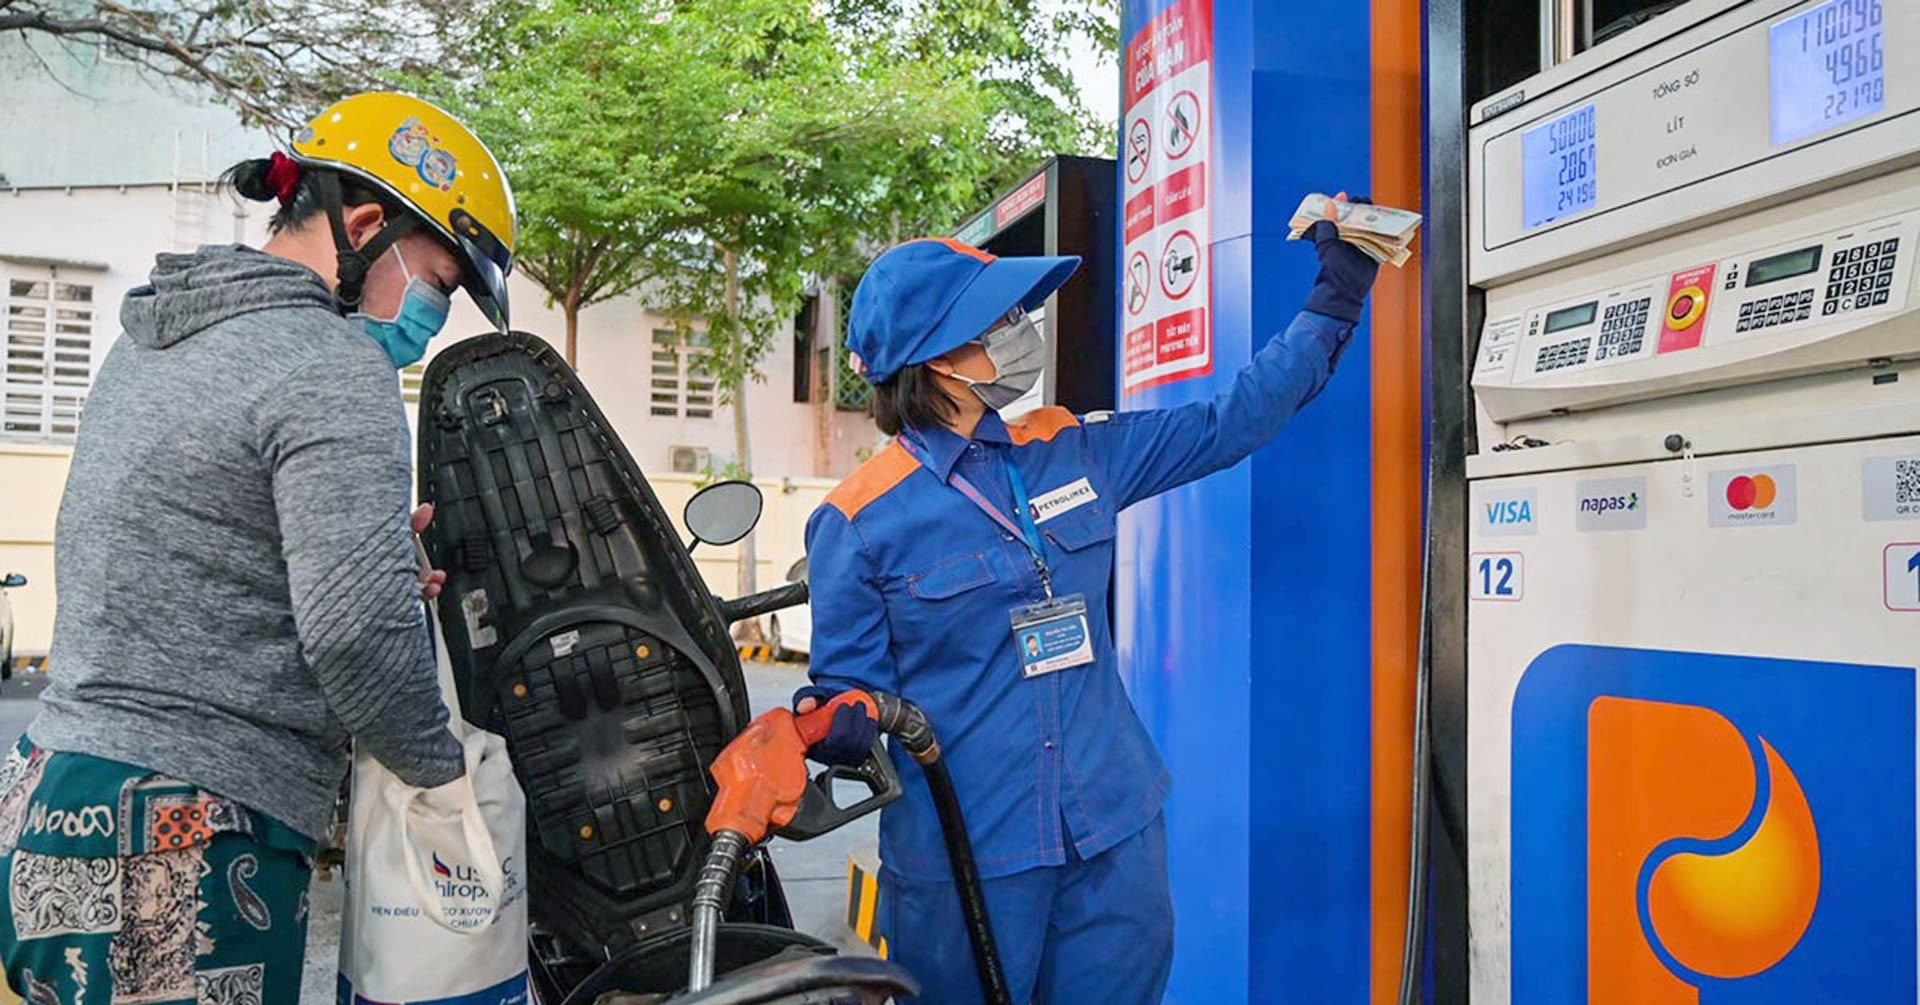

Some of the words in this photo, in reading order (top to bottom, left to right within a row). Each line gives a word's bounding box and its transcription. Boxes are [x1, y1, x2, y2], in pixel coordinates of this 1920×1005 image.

[1667, 115, 1684, 133] LÍT
[1836, 252, 1845, 264] 7
[1851, 248, 1861, 260] 8
[1868, 244, 1878, 257] 9
[1831, 268, 1841, 280] 4
[1848, 265, 1858, 277] 5
[1865, 261, 1875, 273] 6
[1830, 285, 1837, 297] 1
[1845, 281, 1855, 294] 2
[1861, 278, 1871, 291] 3
[1825, 302, 1835, 314] 0
[1842, 298, 1852, 310] C
[1485, 499, 1531, 524] VISA
[1580, 496, 1625, 515] napas
[1896, 505, 1910, 514] QR
[1728, 511, 1775, 521] mastercard
[1479, 558, 1513, 595] 12
